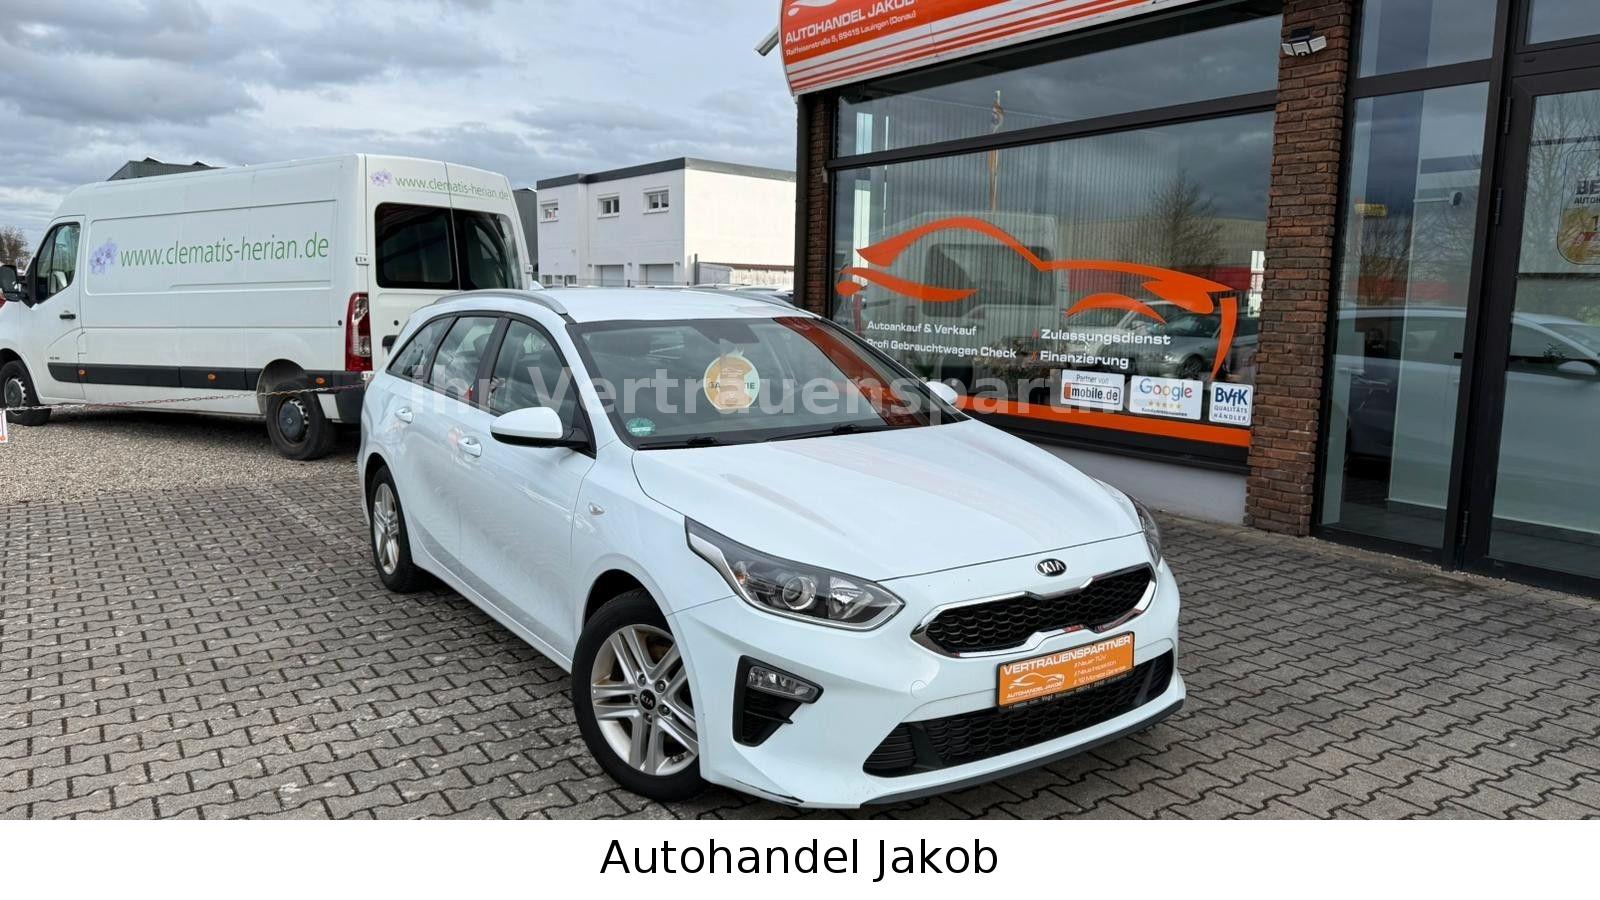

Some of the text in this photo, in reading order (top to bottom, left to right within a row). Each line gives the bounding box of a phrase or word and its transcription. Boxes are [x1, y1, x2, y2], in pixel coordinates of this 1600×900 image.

[785, 8, 866, 44] AUTOHANDEL
[394, 175, 509, 200] www.clematis-herian.de
[120, 231, 329, 267] www.clematis-herian.de
[866, 320, 977, 336] Autoankauf & Verkauf
[1040, 328, 1171, 345] Zulassungsdienst
[890, 340, 978, 358] Gebrauchtwagen
[980, 346, 1017, 359] Check
[1039, 350, 1129, 369] Finanzierung
[1071, 387, 1118, 401] mobile.de
[1139, 378, 1193, 401] Google
[1214, 387, 1248, 406] BVfK
[1040, 560, 1065, 574] KIA
[1003, 634, 1132, 675] VERTRAUENSPARTNER
